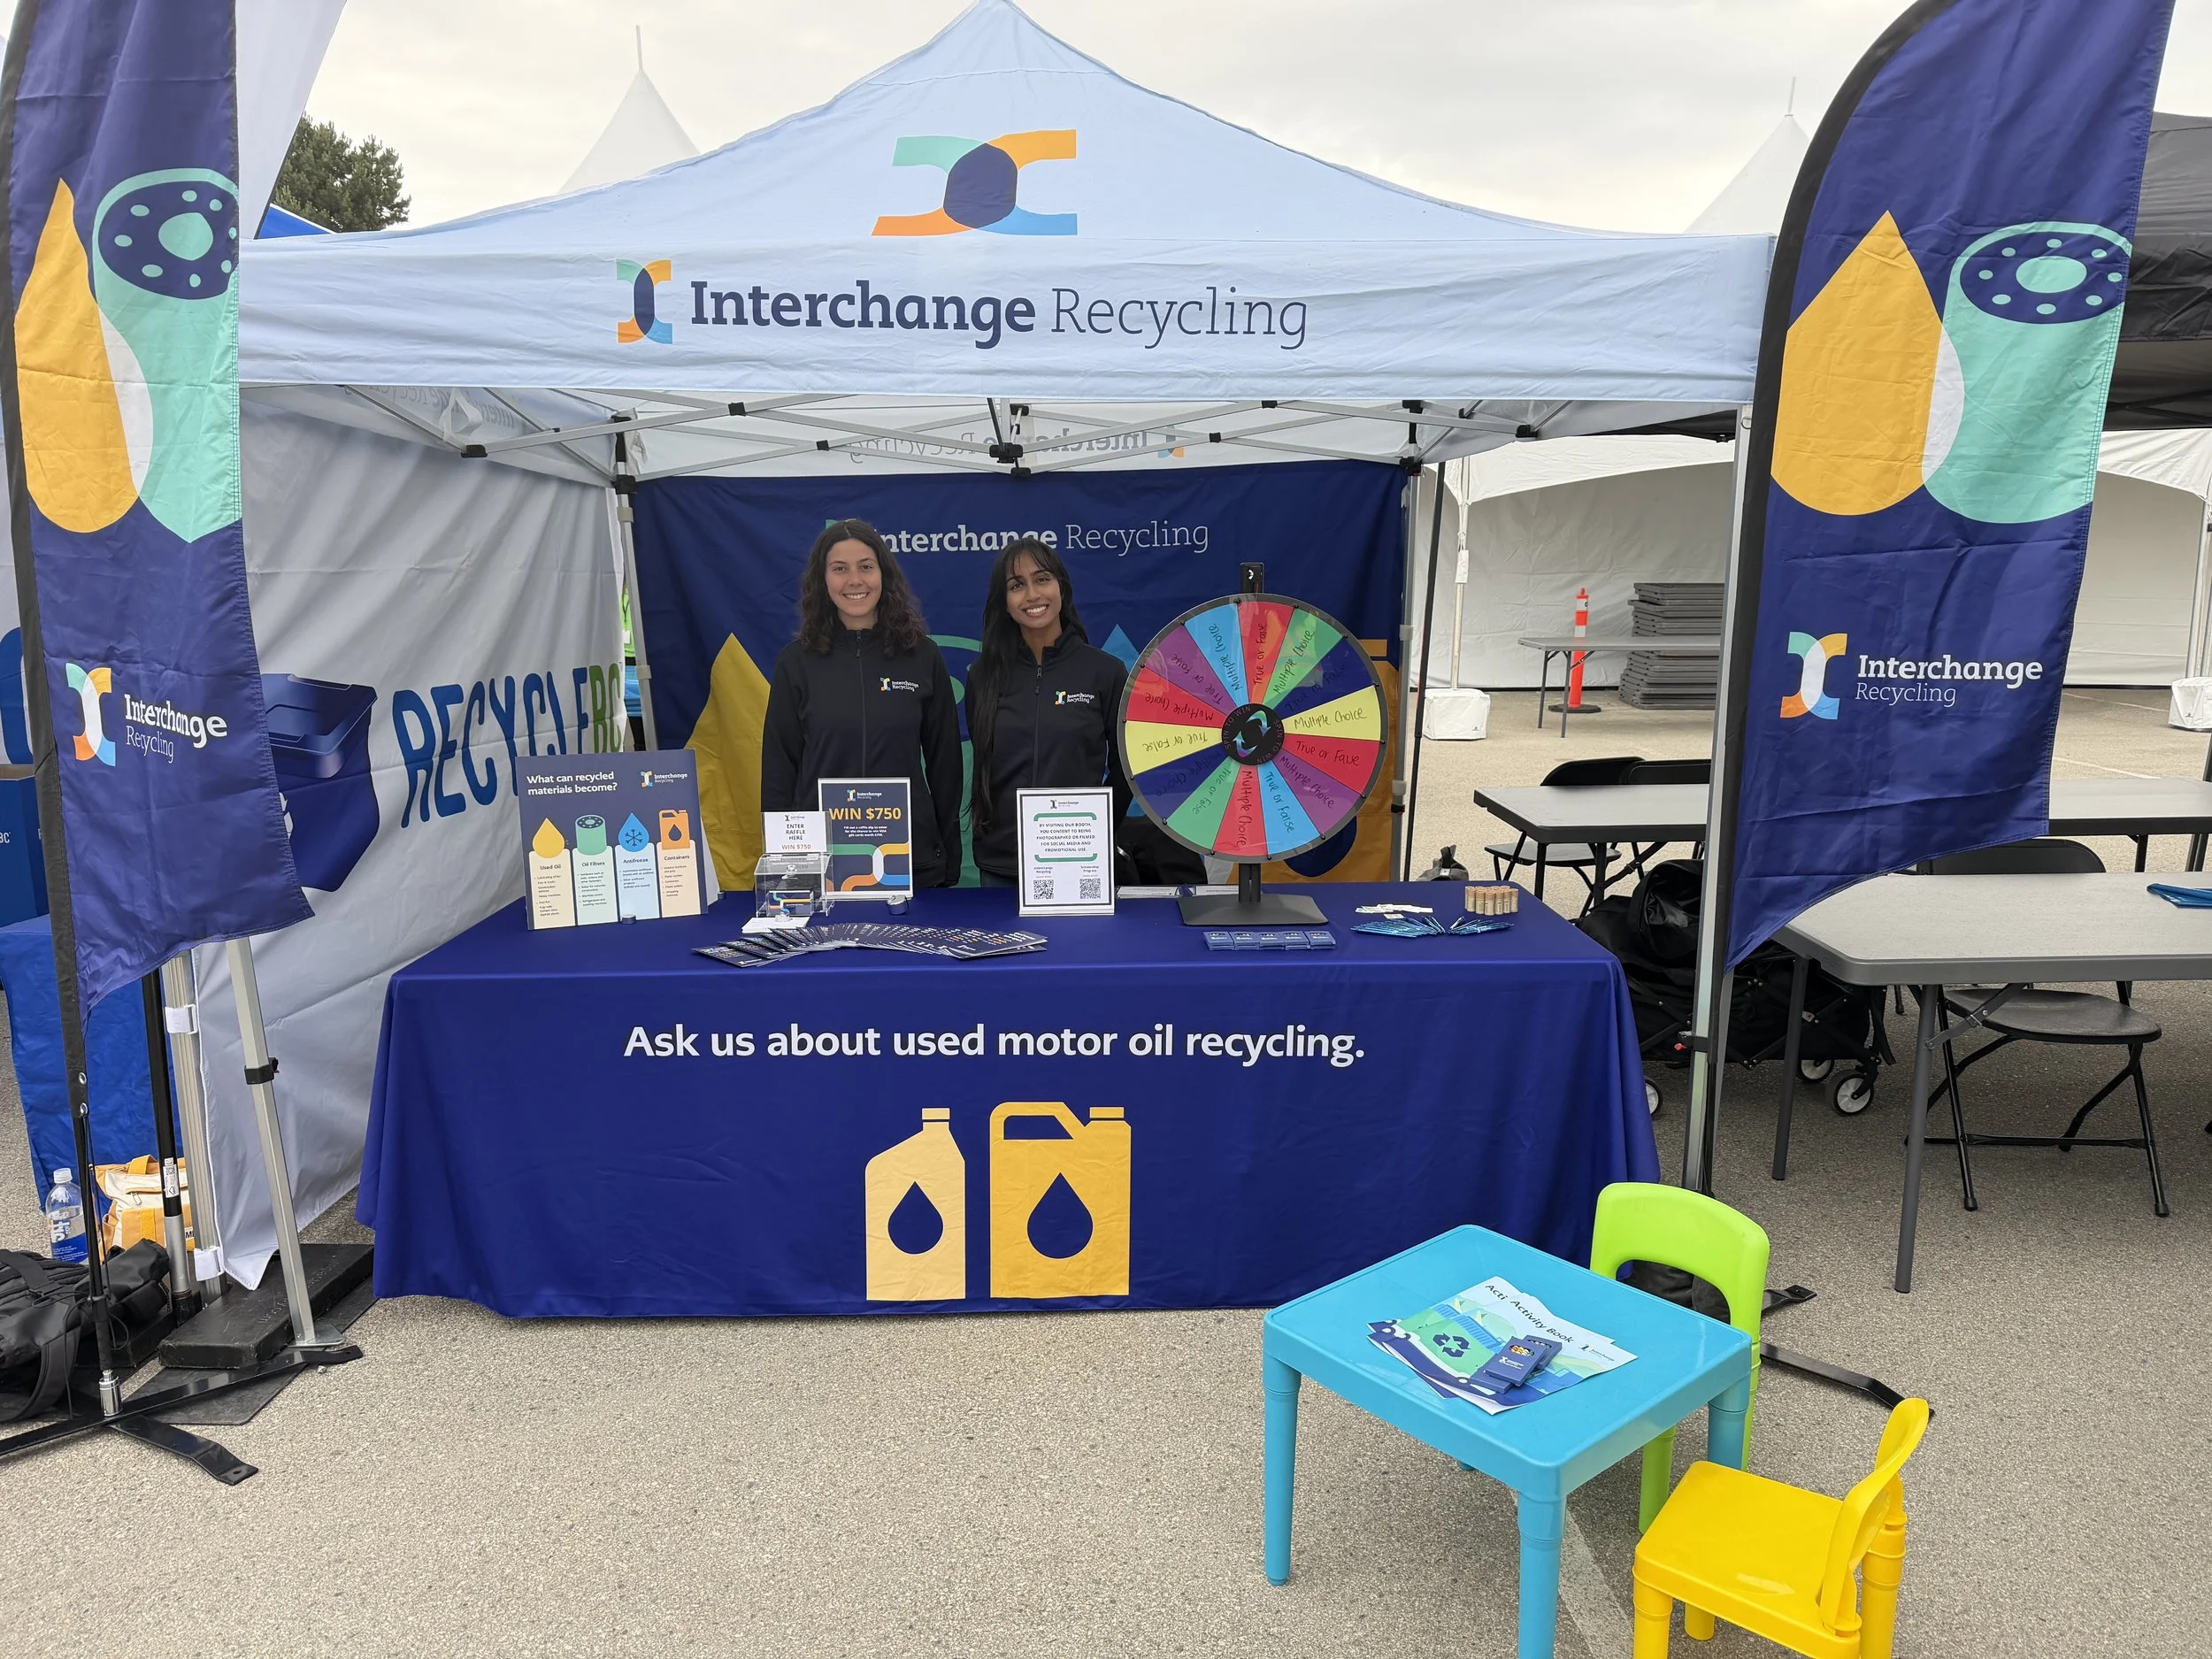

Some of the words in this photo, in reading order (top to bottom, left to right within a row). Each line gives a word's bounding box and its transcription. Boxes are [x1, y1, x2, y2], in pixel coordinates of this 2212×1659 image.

[690, 280, 1036, 349] Interchange
[1051, 286, 1309, 350] Recycling
[880, 524, 1058, 553] nterchane
[1065, 520, 1210, 557] Recycling
[1208, 623, 1225, 653] Choice
[1257, 650, 1265, 659] or
[1273, 658, 1296, 694] Multiple
[1293, 629, 1316, 657] Choice
[1194, 674, 1204, 683] or
[1220, 654, 1242, 691] Multiple
[1254, 665, 1263, 686] True
[1856, 655, 2043, 689] Interchange
[1145, 693, 1170, 710] Choice
[1205, 683, 1224, 705] True
[1855, 682, 1956, 708] Recycling
[1173, 703, 1214, 721] Multiple
[1234, 706, 1252, 717] WIN
[1294, 714, 1332, 730] Multiple
[1334, 707, 1368, 723] Choice
[124, 694, 227, 749] Interchange
[1225, 717, 1234, 726] TO
[1274, 718, 1283, 738] SPIN
[126, 726, 174, 764] Recycling
[1142, 738, 1170, 753] False
[1173, 735, 1183, 747] or
[1187, 732, 1209, 743] True
[1223, 730, 1232, 749] SPIN
[1272, 741, 1282, 752] TO
[1256, 752, 1274, 764] WIN
[1295, 741, 1316, 756] True
[1318, 749, 1328, 759] or
[526, 774, 555, 785] What
[556, 774, 573, 783] can
[575, 772, 615, 784] recycled
[1216, 767, 1232, 786] True
[1263, 772, 1279, 793] True
[1280, 755, 1311, 787] Multiple
[1310, 783, 1335, 810] Choice
[527, 785, 573, 796] materials
[575, 782, 618, 794] become?
[1209, 786, 1217, 796] or
[1238, 770, 1253, 812] Multiple
[1192, 796, 1212, 815] False
[1273, 795, 1285, 803] or
[828, 807, 862, 820] WIN
[865, 807, 902, 821] $750
[1278, 806, 1294, 833] False
[1237, 815, 1253, 848] Choice
[624, 1024, 700, 1057] Ask
[710, 1031, 755, 1057] us
[766, 1025, 879, 1057] about
[893, 1025, 984, 1056] used
[998, 1026, 1118, 1056] motor
[1128, 1025, 1172, 1056] oil
[1186, 1025, 1365, 1067] recycling.
[1510, 1300, 1548, 1329] Activity
[1547, 1327, 1574, 1343] Book
